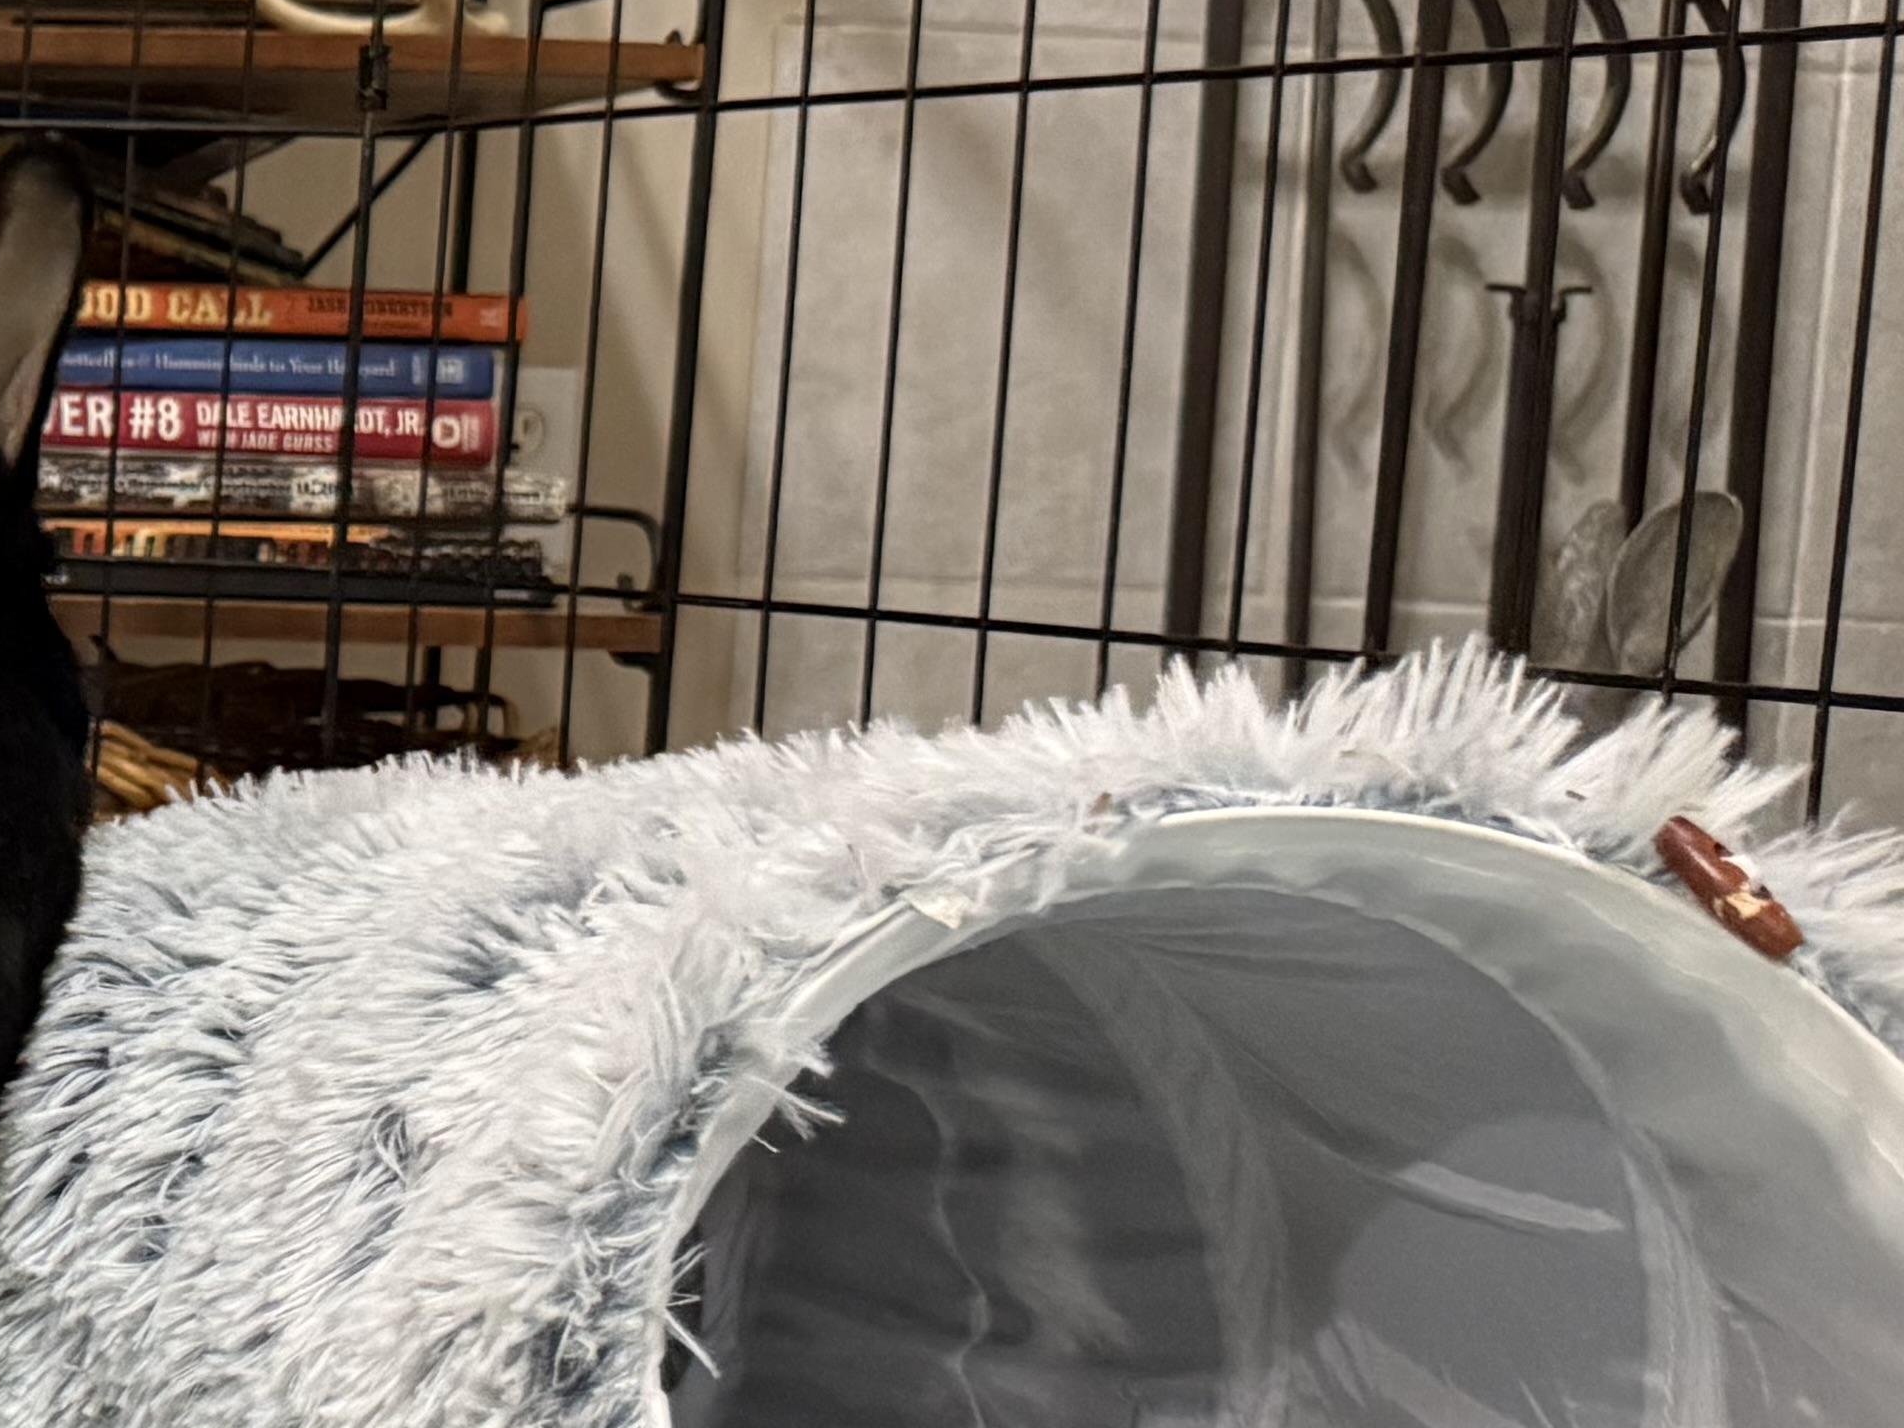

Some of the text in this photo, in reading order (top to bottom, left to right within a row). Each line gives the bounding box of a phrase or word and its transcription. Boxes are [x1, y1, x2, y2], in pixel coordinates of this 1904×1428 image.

[289, 355, 323, 374] Your
[128, 396, 182, 442] #8
[196, 400, 252, 428] DALE
[256, 403, 390, 438] EARNHADT,
[394, 409, 425, 436] JR.
[197, 430, 238, 448] WIH
